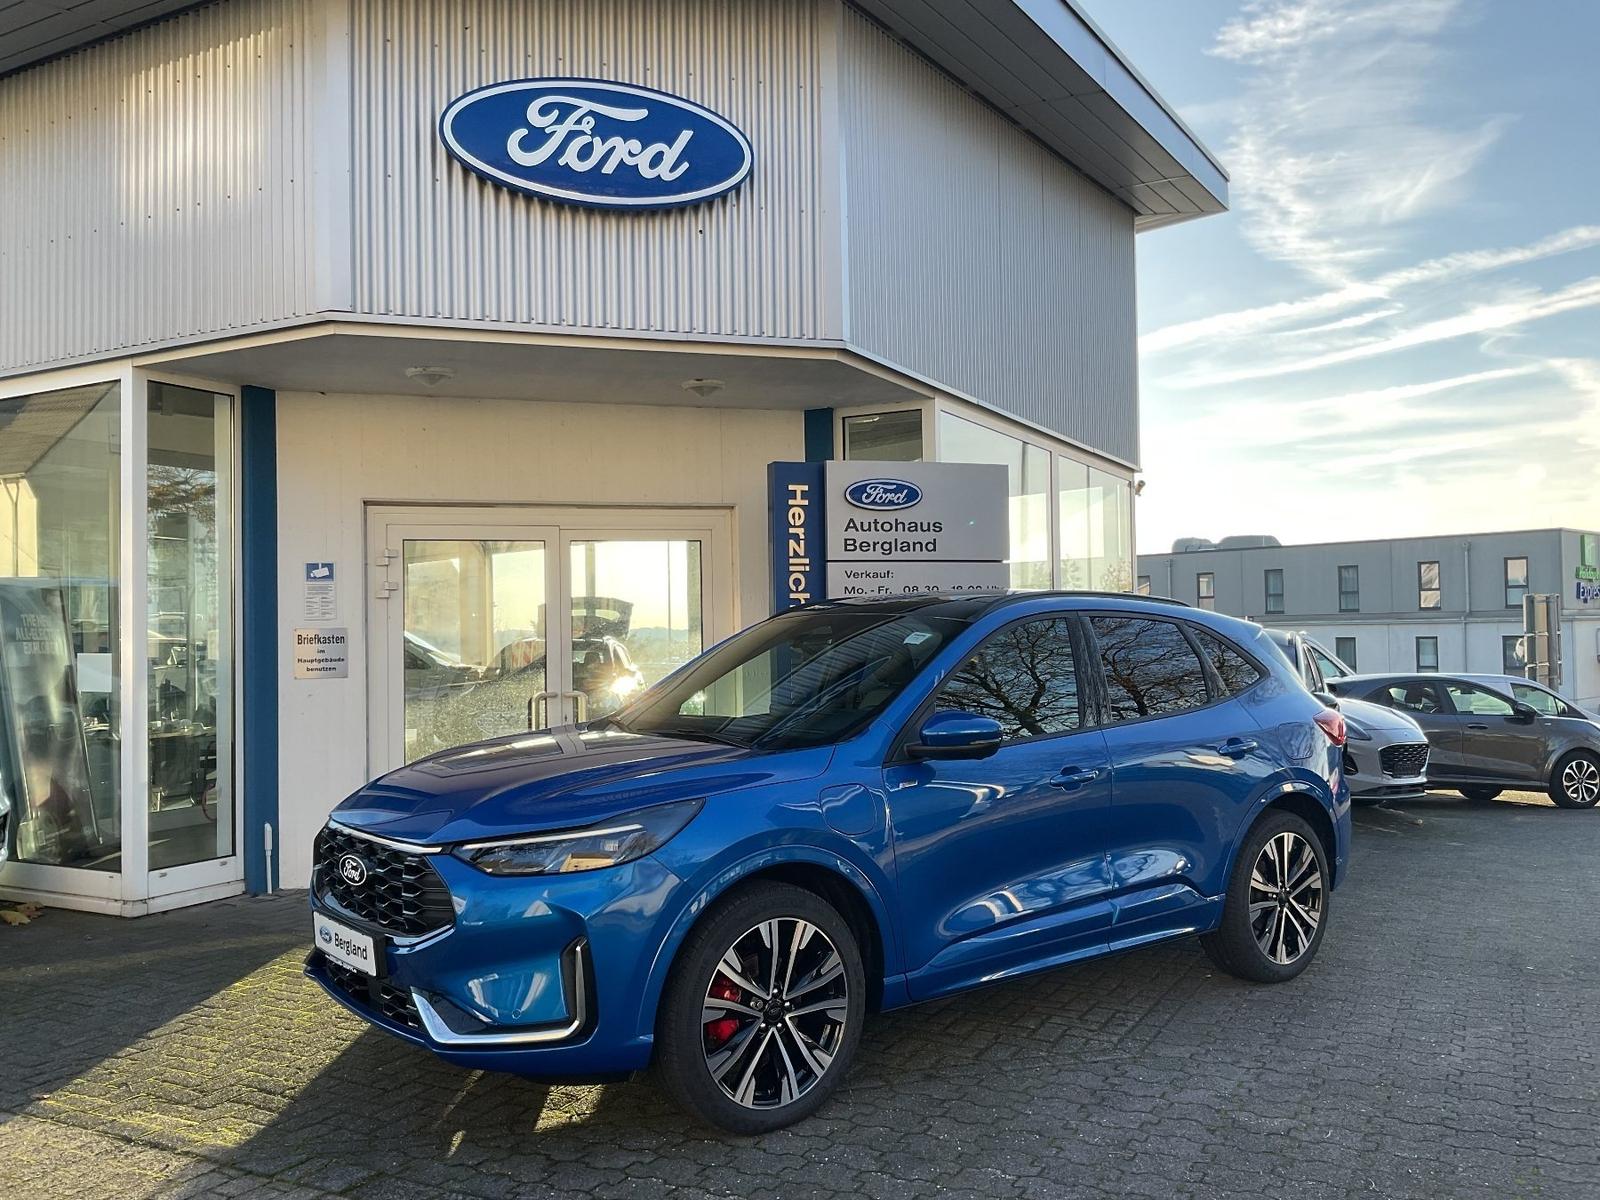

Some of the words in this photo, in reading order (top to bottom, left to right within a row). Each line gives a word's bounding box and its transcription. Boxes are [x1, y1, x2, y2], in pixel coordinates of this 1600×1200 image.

[507, 95, 694, 181] Ford
[861, 483, 908, 504] Ford
[843, 517, 943, 533] Autohaus
[843, 538, 937, 556] Bergland
[844, 569, 894, 579] Verkauf:
[844, 585, 868, 595] Mo.
[877, 585, 893, 595] Fr.
[297, 633, 345, 645] Briefkasten
[297, 657, 345, 666] Hauptgebäude
[342, 858, 361, 882] Ford
[334, 933, 368, 960] Bergland
